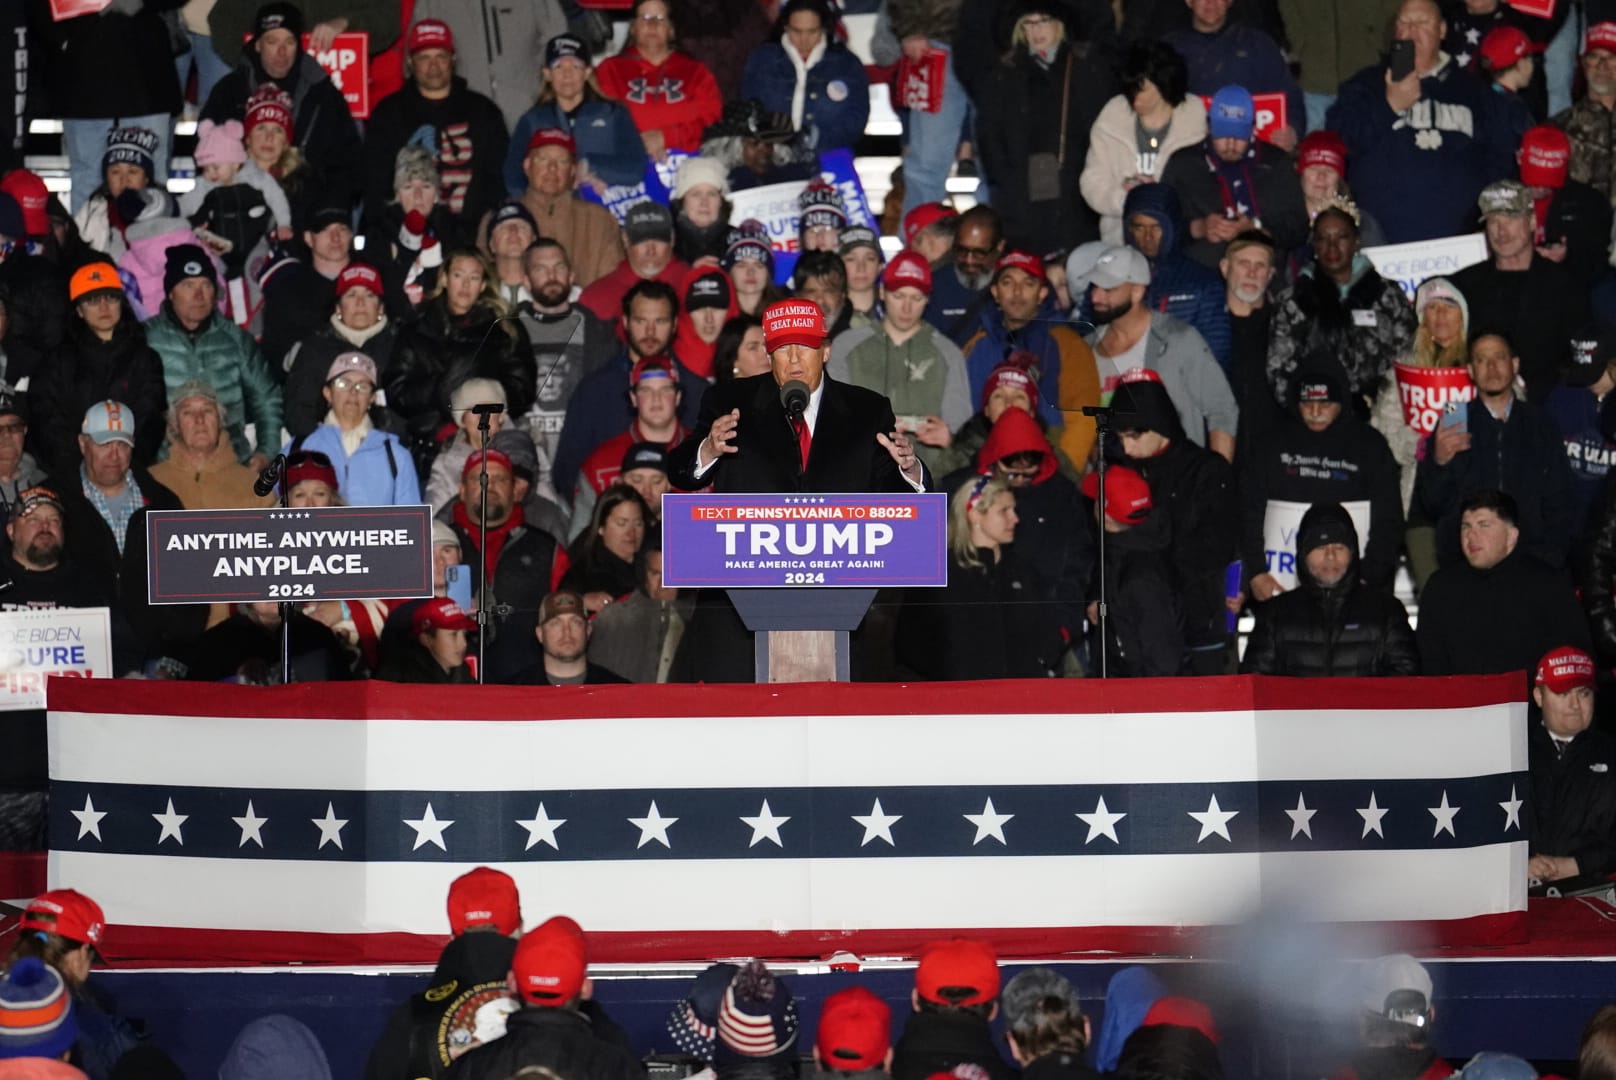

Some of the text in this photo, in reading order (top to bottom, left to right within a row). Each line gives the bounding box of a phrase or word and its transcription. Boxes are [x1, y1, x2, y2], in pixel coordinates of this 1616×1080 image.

[766, 306, 818, 320] MAKE AMERICA
[771, 318, 814, 332] GREAT AGAIN
[1400, 384, 1477, 407] TRUM
[699, 508, 913, 519] TEXT PENNSYLVANIA TO 88022
[166, 529, 415, 551] ANYTIME. ANYWHERE.
[716, 523, 894, 555] TRUMP
[213, 554, 370, 577] ANYPLACE.
[725, 561, 885, 569] MAKE AMERICA GREAT AGAIN!
[785, 572, 825, 584] 2024
[268, 584, 315, 597] 2024
